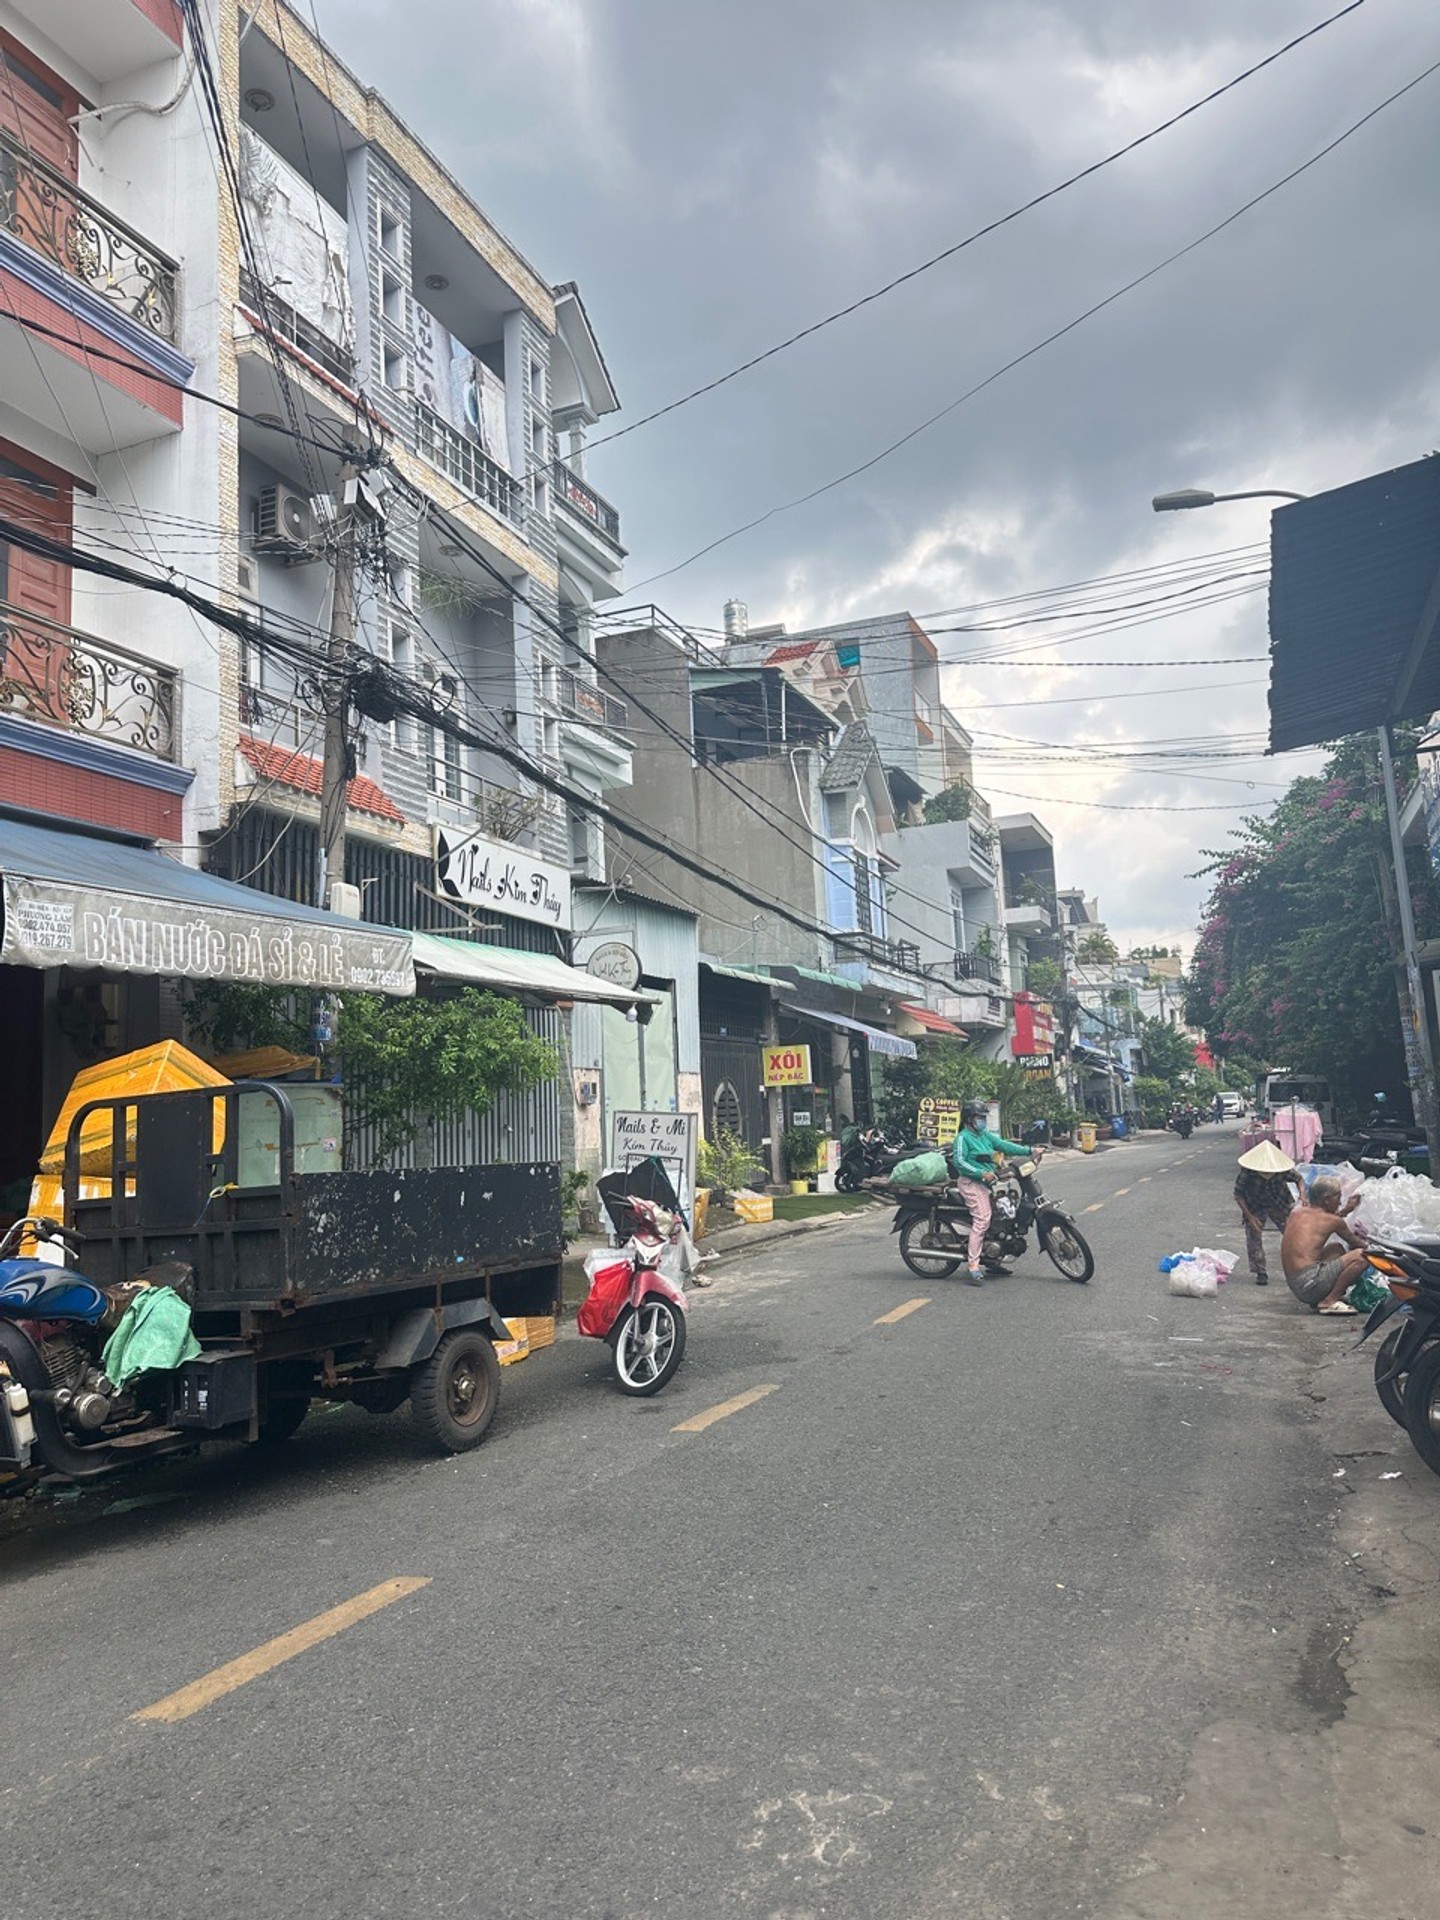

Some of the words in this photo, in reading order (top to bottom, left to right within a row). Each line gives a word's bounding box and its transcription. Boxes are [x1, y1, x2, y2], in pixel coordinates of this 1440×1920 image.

[458, 844, 492, 892] Nails
[493, 863, 527, 903] Kim
[83, 906, 147, 967] BÁN
[152, 919, 225, 975] NƯỚC
[229, 927, 264, 978] ĐÁ
[269, 926, 293, 981] SỈ
[297, 941, 317, 982] &
[319, 933, 345, 985] LẺ
[769, 1050, 803, 1071] XÔI
[616, 1116, 647, 1134] Nails
[650, 1117, 662, 1135] &
[666, 1118, 687, 1136] Mi
[622, 1137, 645, 1151] Kim
